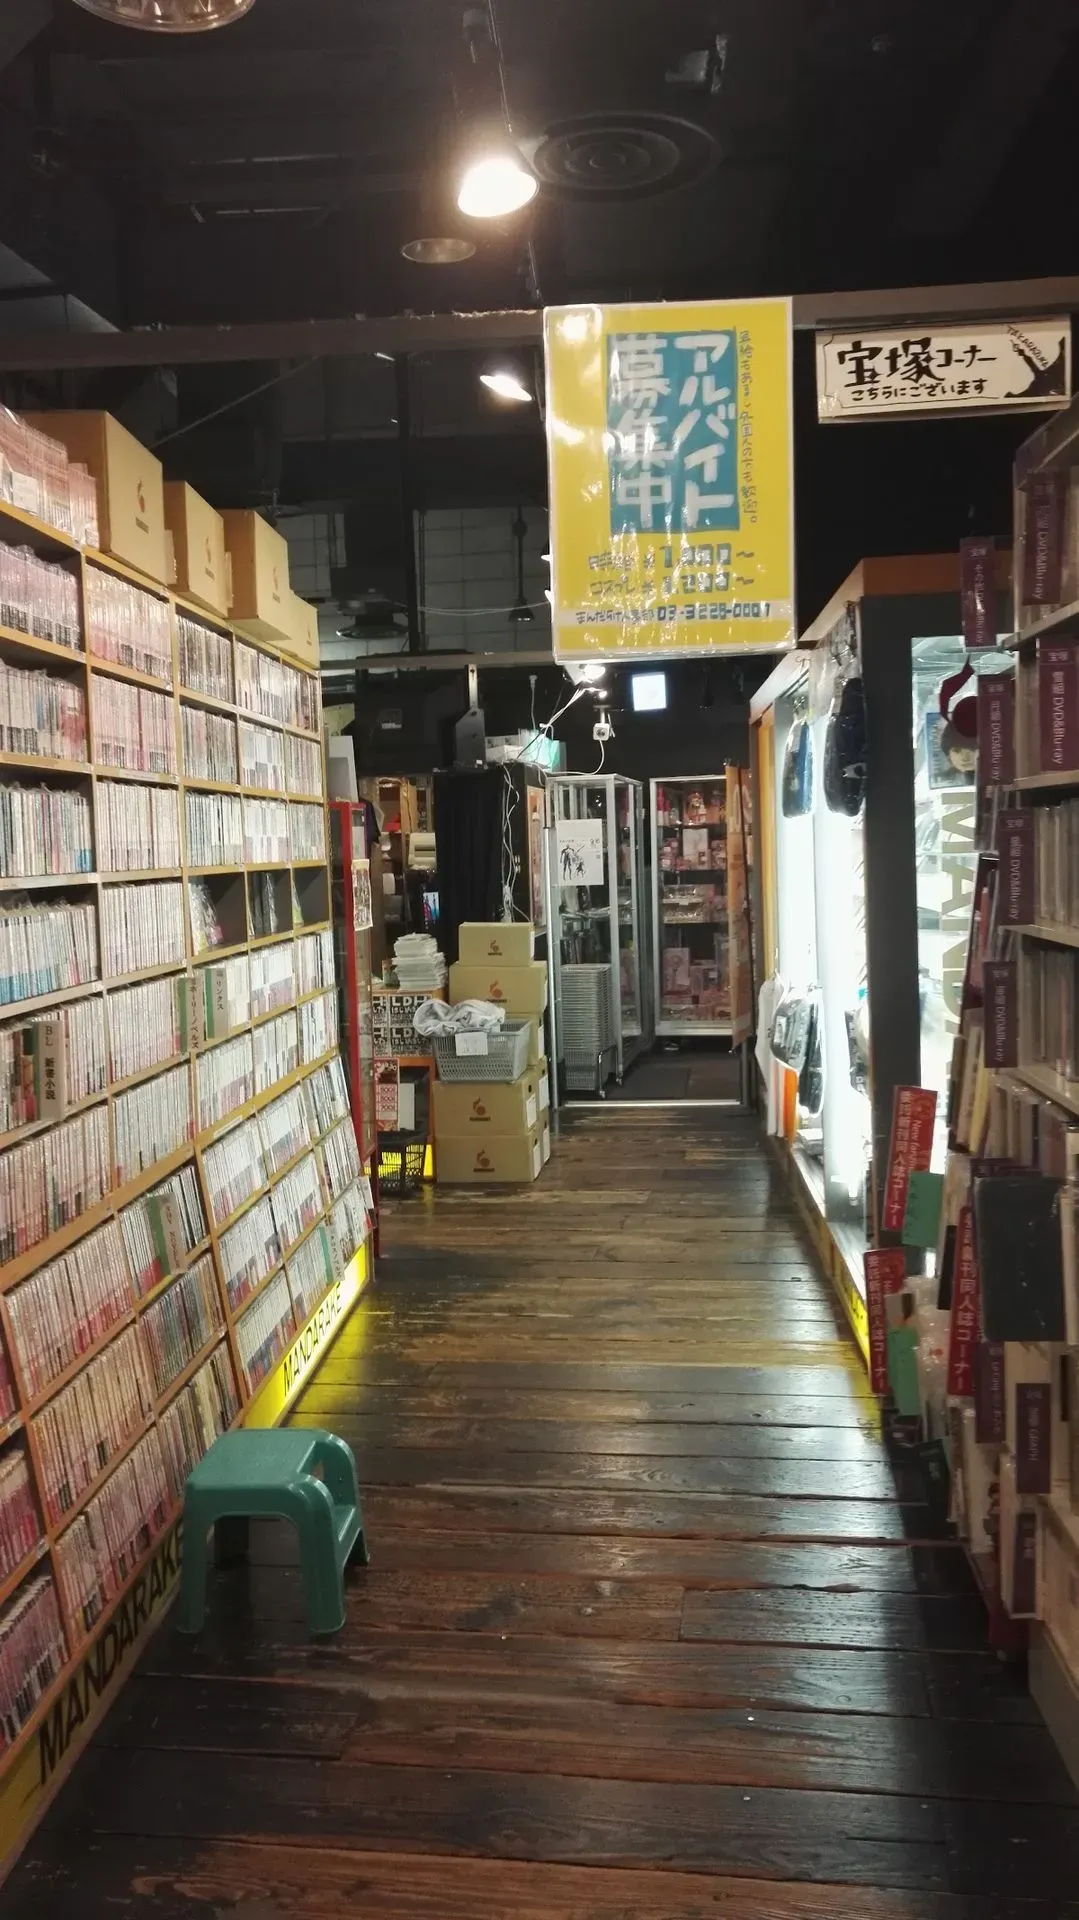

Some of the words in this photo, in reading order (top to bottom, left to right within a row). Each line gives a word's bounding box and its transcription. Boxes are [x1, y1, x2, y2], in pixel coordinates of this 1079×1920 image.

[837, 336, 998, 388] 宝塚コーナー
[851, 378, 988, 401] こちらにございます
[614, 333, 674, 529] 募集中
[674, 334, 736, 528] アルバイト
[990, 722, 1003, 780] DVD&Blu-ray
[1051, 697, 1065, 765] DVD&Blu-ray
[1008, 859, 1023, 920] DVD&Blu-ray
